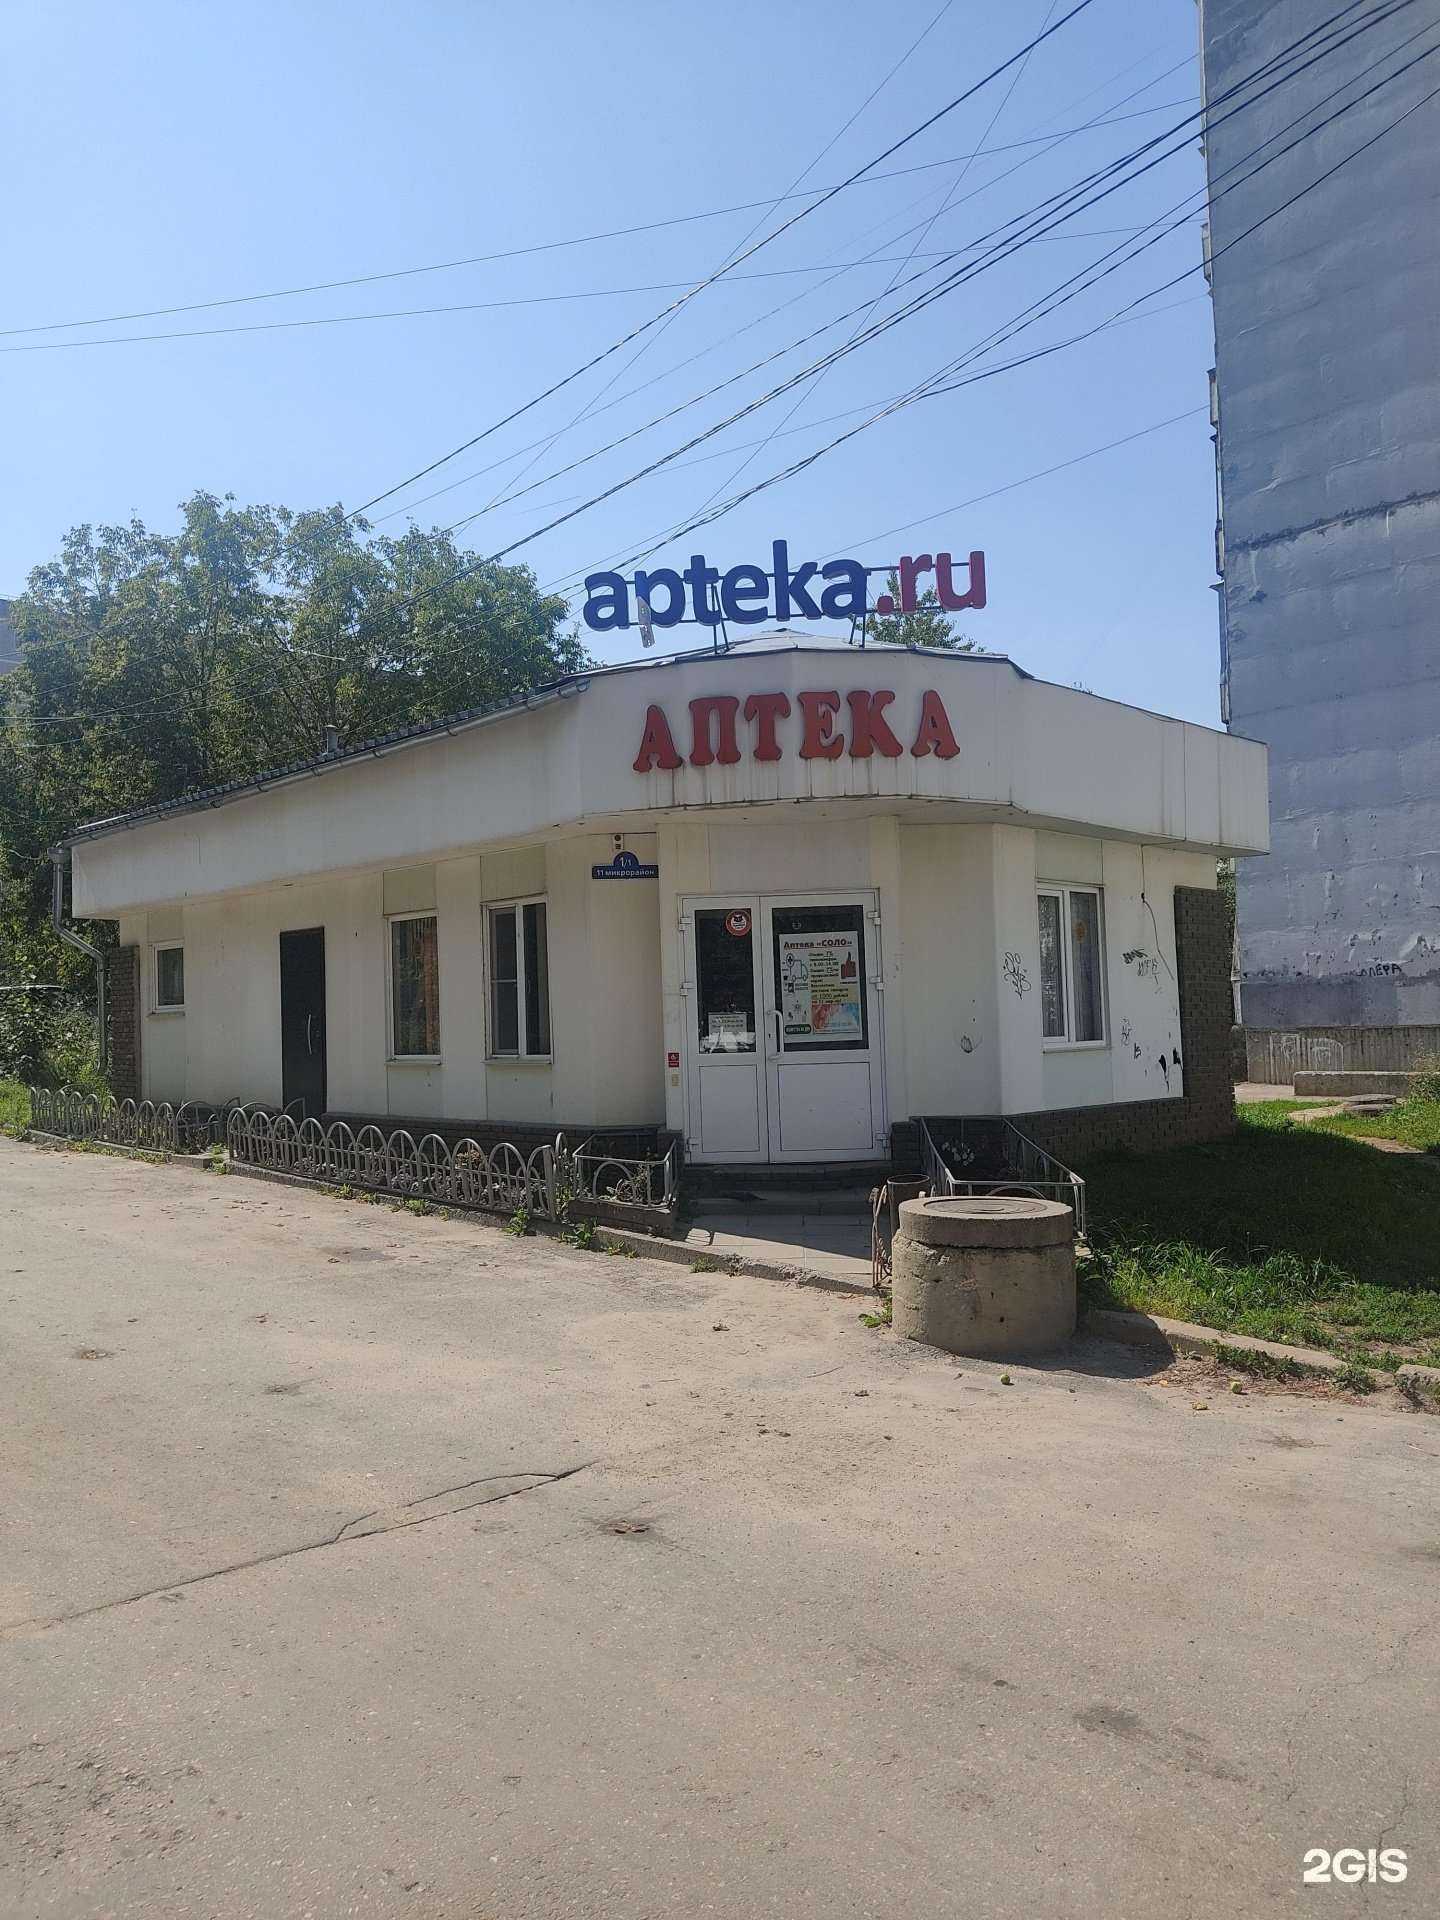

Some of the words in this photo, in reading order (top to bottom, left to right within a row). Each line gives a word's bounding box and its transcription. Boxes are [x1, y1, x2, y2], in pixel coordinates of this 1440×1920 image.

[583, 539, 987, 645] apteka.ru
[632, 688, 962, 774] АПТЕКА
[596, 869, 604, 877] 11
[605, 869, 655, 877] микрорайон
[618, 856, 633, 869] 1/1
